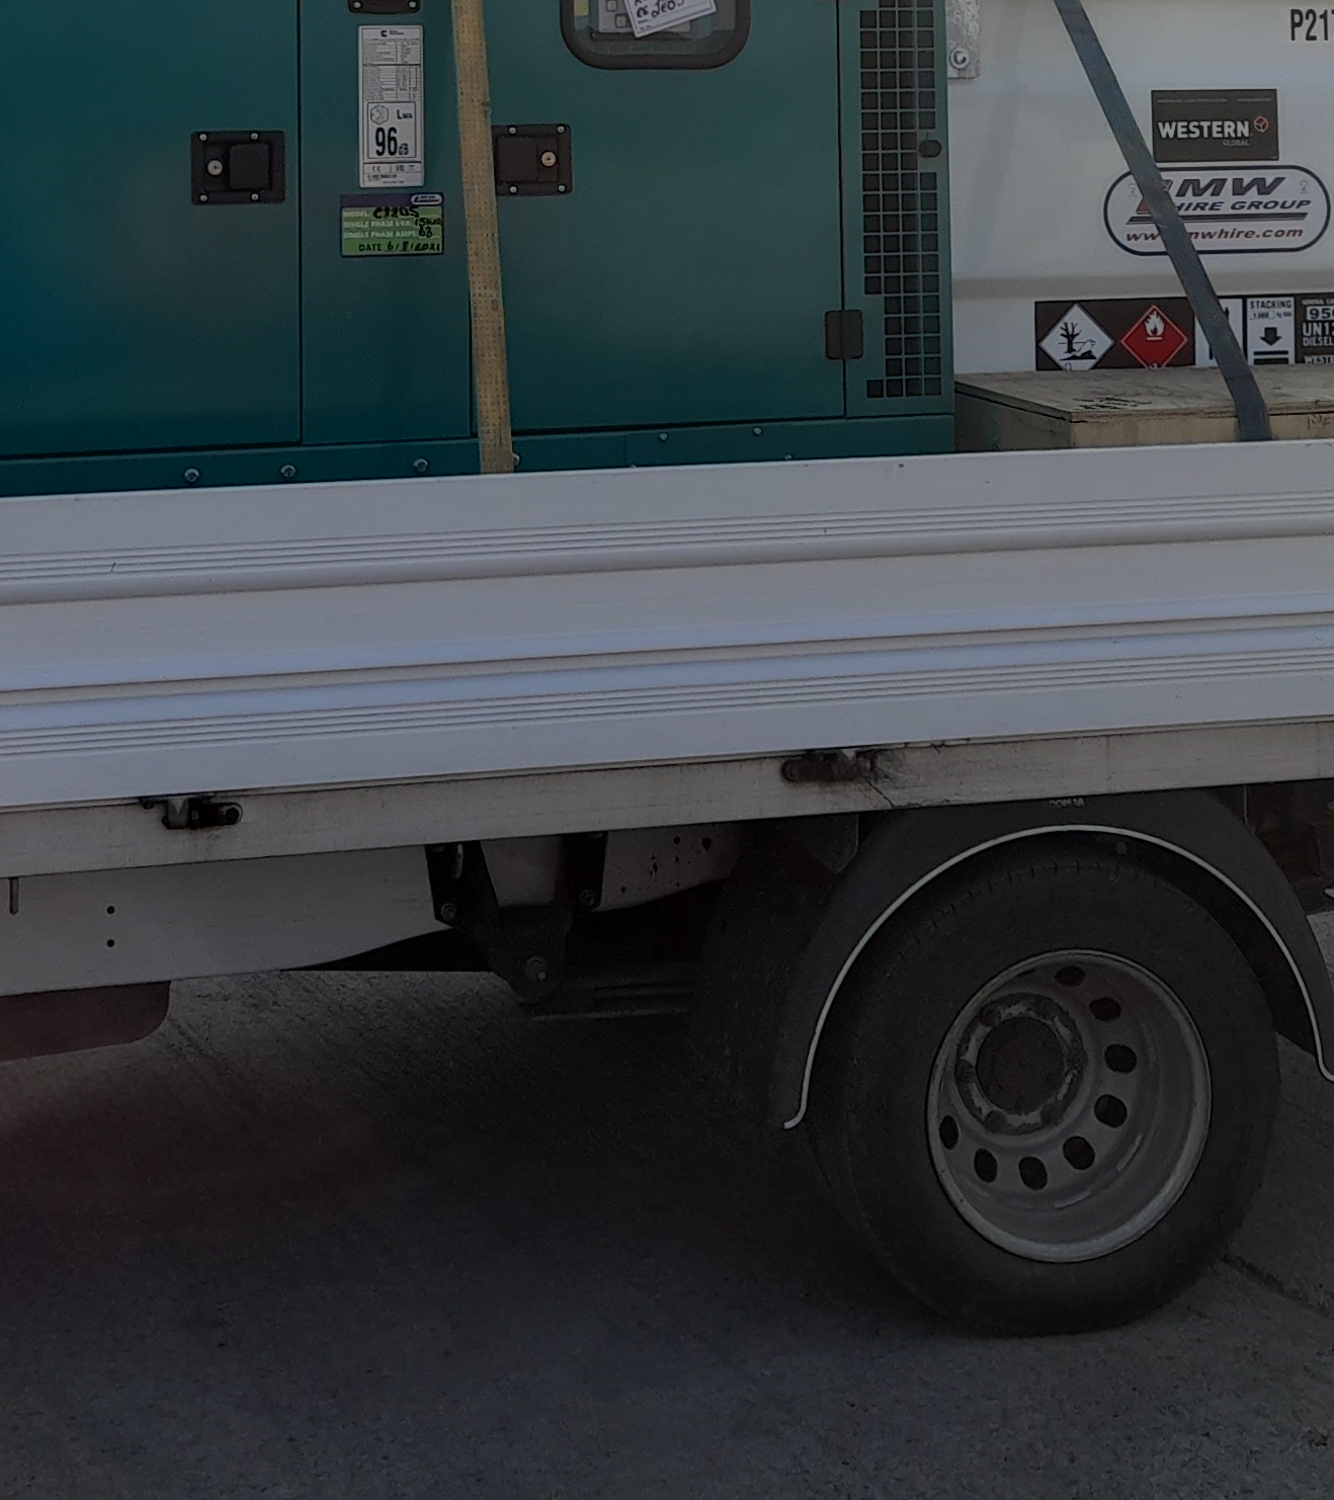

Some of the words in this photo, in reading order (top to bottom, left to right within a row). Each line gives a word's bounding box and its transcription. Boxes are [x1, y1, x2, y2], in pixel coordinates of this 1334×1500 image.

[1157, 120, 1250, 139] WESTERN
[1175, 176, 1286, 197] MW
[1230, 199, 1311, 211] GROUP
[1250, 300, 1292, 309] STACKING
[1302, 336, 1334, 347] DIESEL
